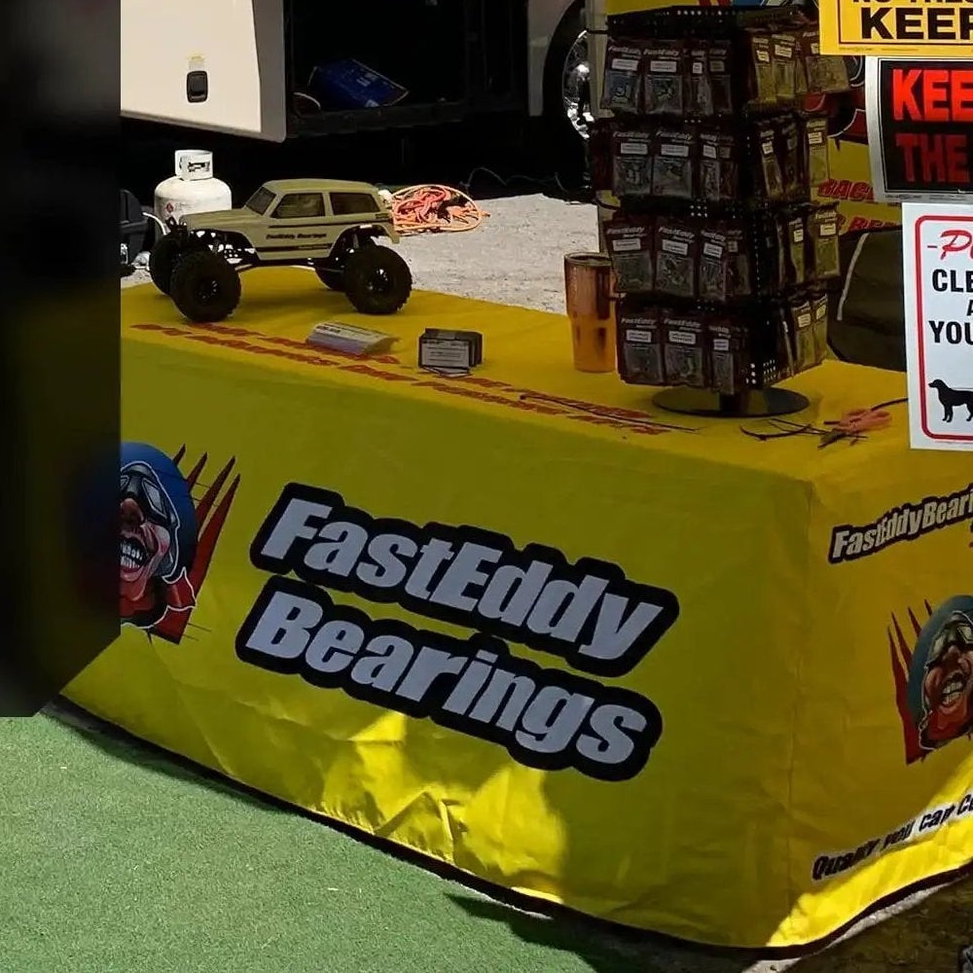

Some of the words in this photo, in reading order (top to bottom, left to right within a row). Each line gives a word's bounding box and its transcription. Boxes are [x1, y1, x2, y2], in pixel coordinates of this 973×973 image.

[895, 133, 970, 182] THE
[260, 497, 664, 661] FastEddy
[245, 590, 649, 765] Bearings
